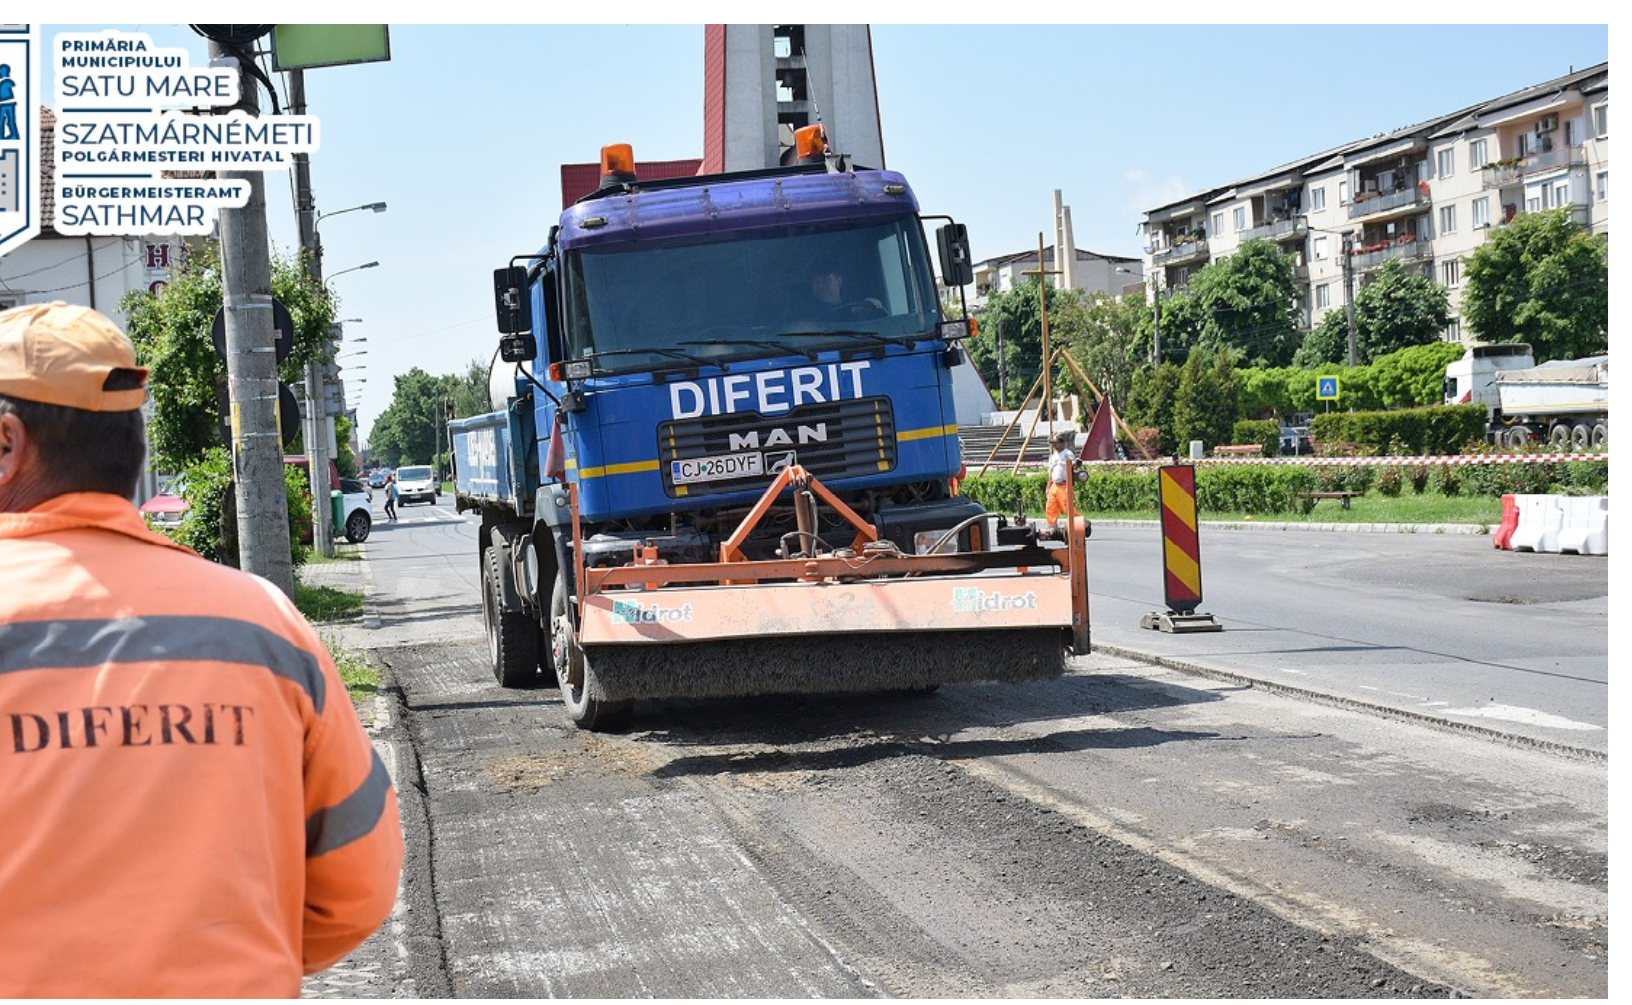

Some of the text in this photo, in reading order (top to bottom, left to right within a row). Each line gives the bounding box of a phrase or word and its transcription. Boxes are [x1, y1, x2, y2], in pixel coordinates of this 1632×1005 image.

[669, 361, 871, 421] DIFERIT
[728, 422, 828, 451] MAN
[6, 703, 255, 754] DIFERIT
